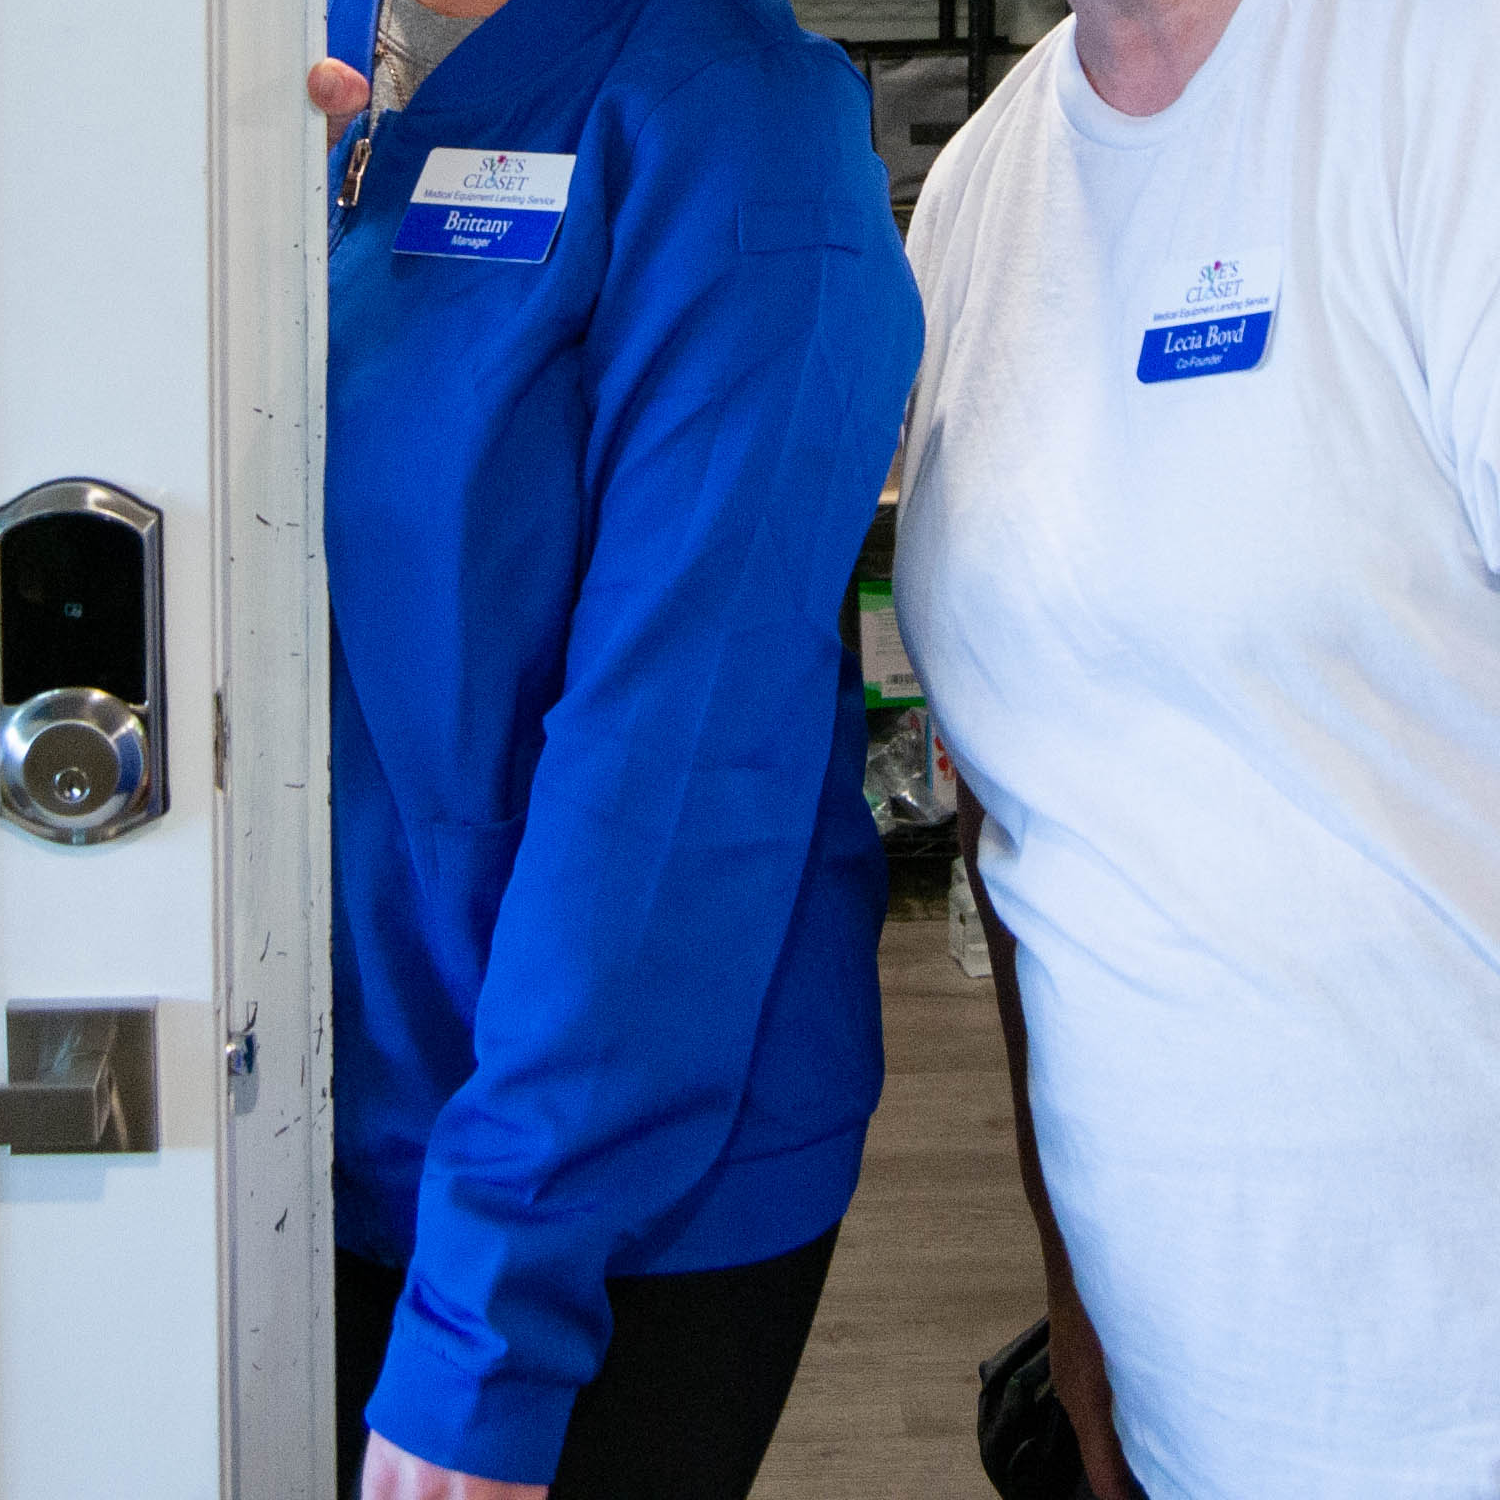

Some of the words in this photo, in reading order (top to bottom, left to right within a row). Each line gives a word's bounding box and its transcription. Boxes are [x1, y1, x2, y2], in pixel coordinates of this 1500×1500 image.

[480, 156, 525, 173] SUE'S
[463, 174, 529, 191] CLOSET
[444, 211, 513, 241] Brittany
[451, 235, 491, 249] Manager
[1186, 279, 1243, 303] CLOSET
[1164, 330, 1202, 354] Lecia
[1206, 319, 1246, 353] Boyd
